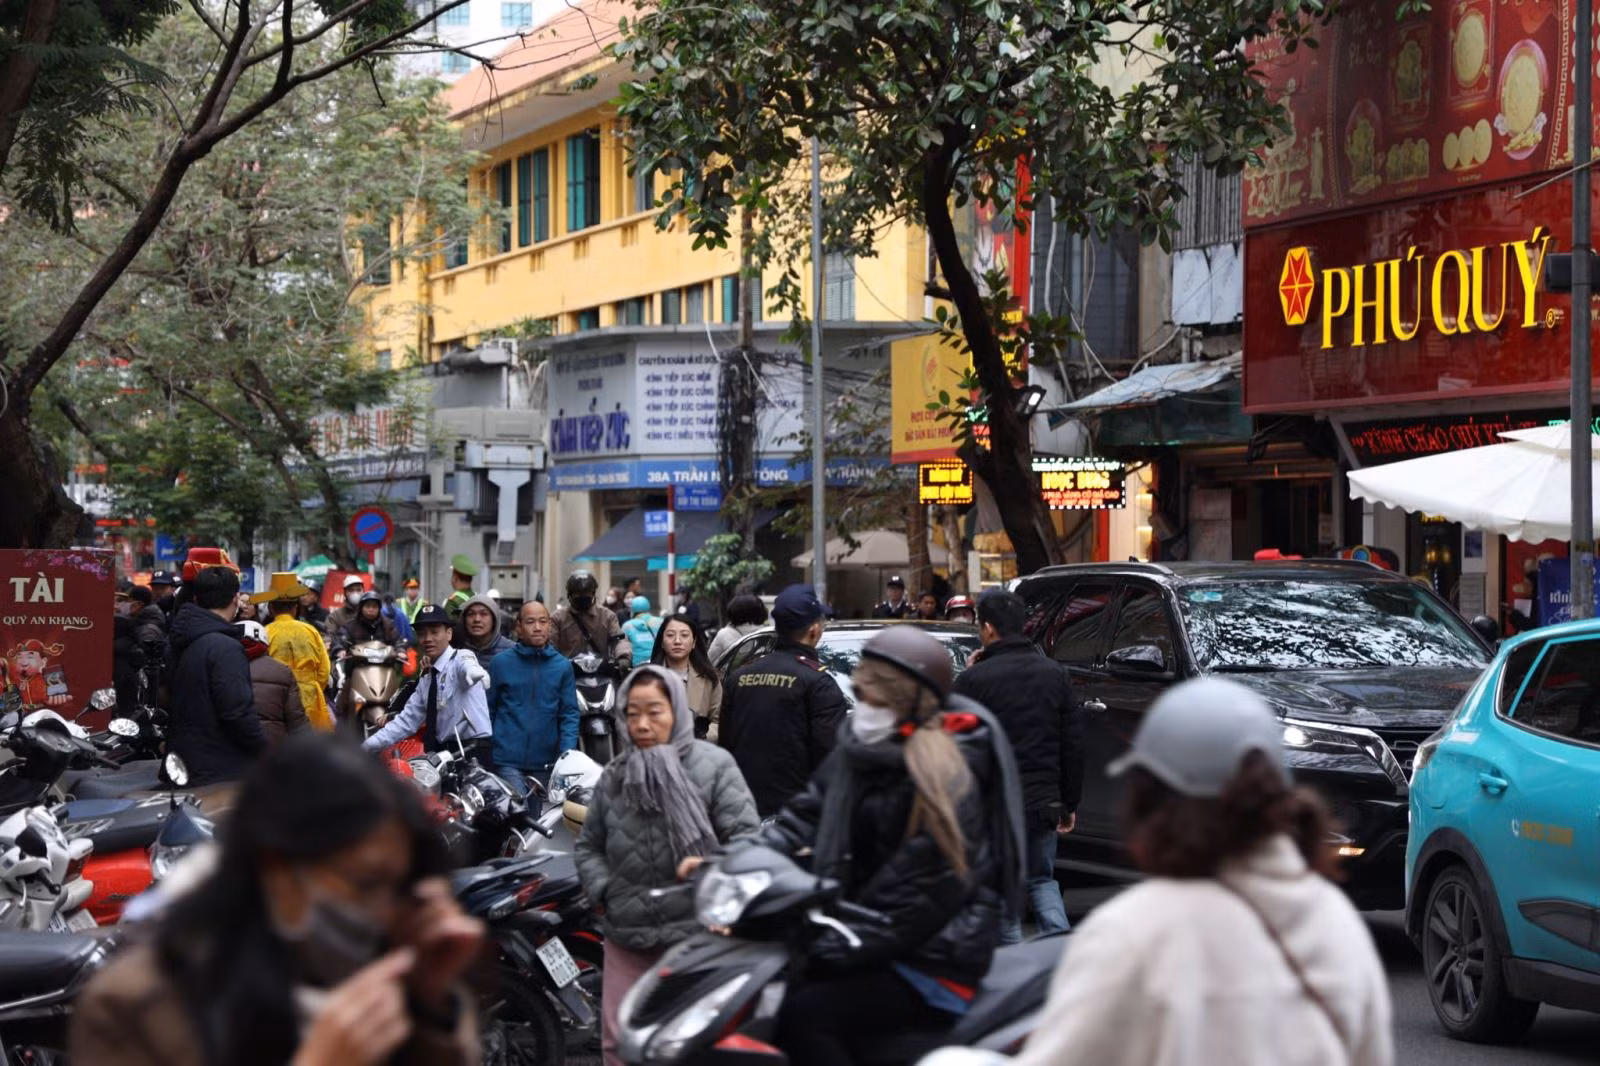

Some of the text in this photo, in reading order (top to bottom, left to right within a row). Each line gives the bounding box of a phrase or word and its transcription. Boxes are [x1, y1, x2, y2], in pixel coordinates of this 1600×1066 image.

[1320, 226, 1549, 350] PHÚ QUÝ
[578, 396, 604, 452] TIẾP
[647, 471, 670, 483] 38A
[672, 467, 707, 484] TRẦN
[9, 572, 65, 603] TÀI
[30, 616, 46, 625] AN
[48, 616, 90, 628] KHANG
[738, 674, 796, 688] SECURITY
